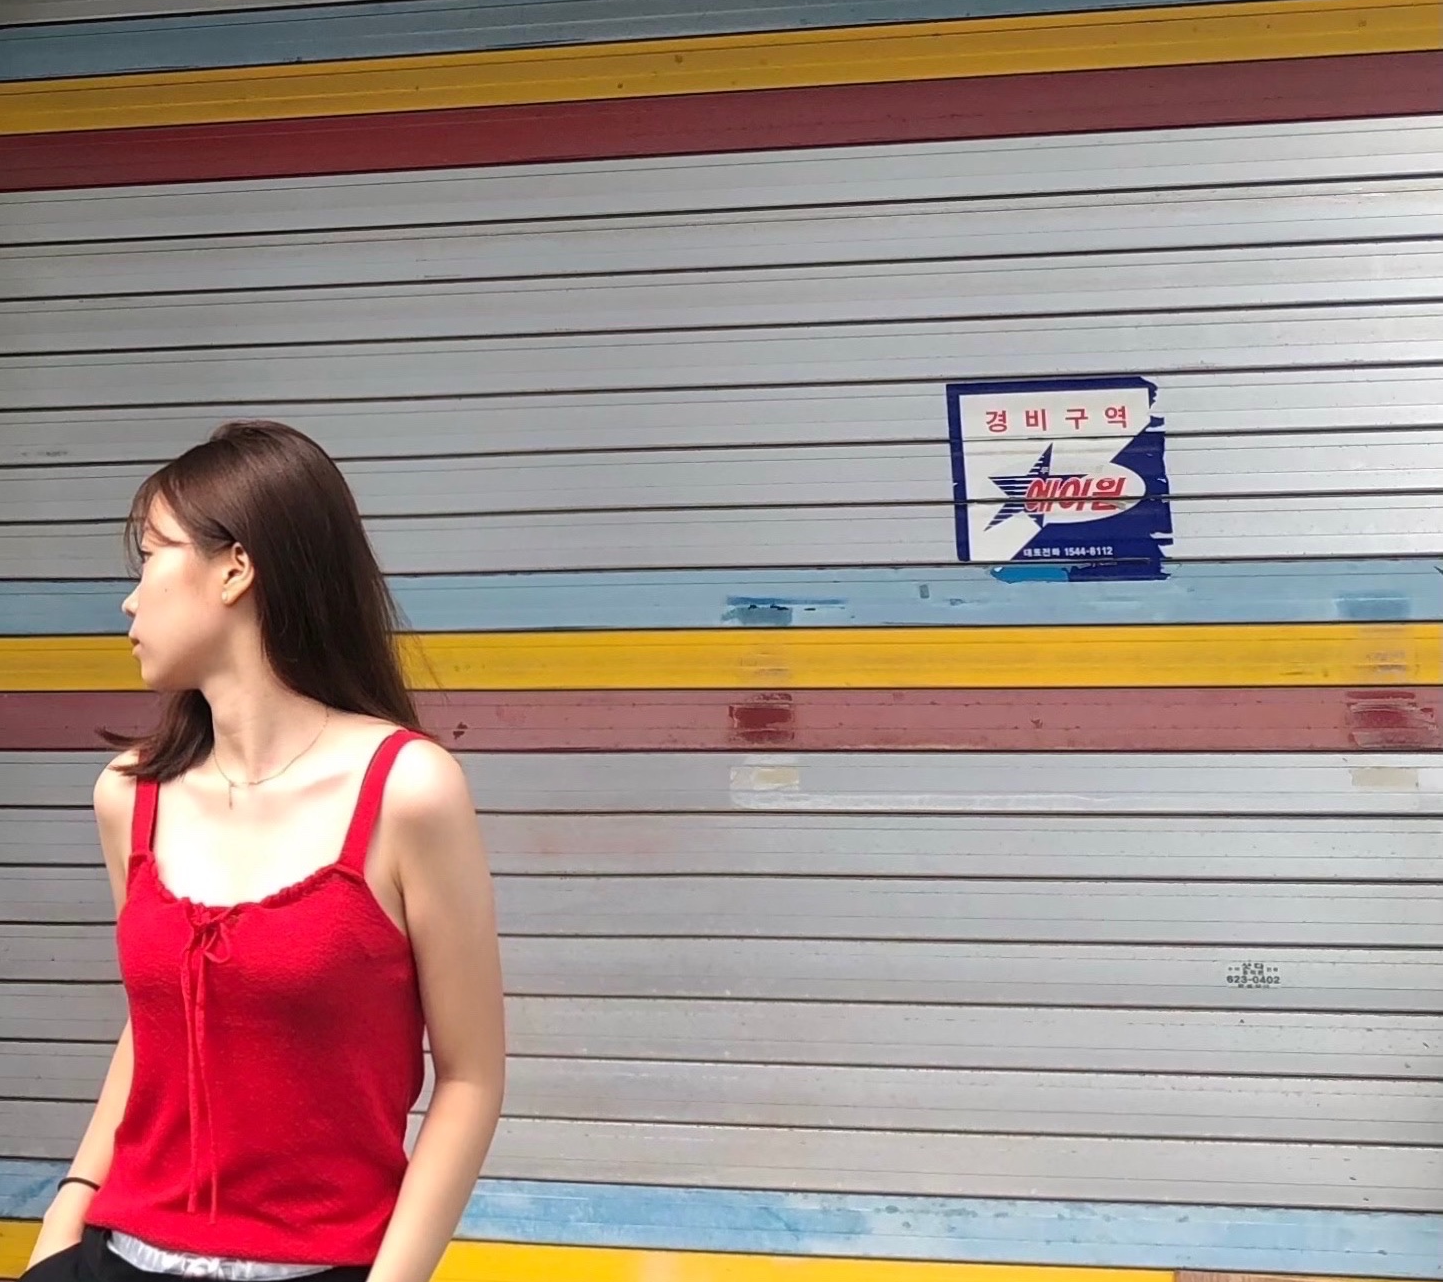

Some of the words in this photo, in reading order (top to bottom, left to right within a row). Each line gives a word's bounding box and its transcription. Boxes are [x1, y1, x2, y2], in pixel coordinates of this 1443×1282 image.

[984, 405, 1128, 433] 경비구역
[1024, 477, 1127, 513] 에이원
[1064, 545, 1114, 557] 1544-8112
[1226, 975, 1281, 984] 623-0402
